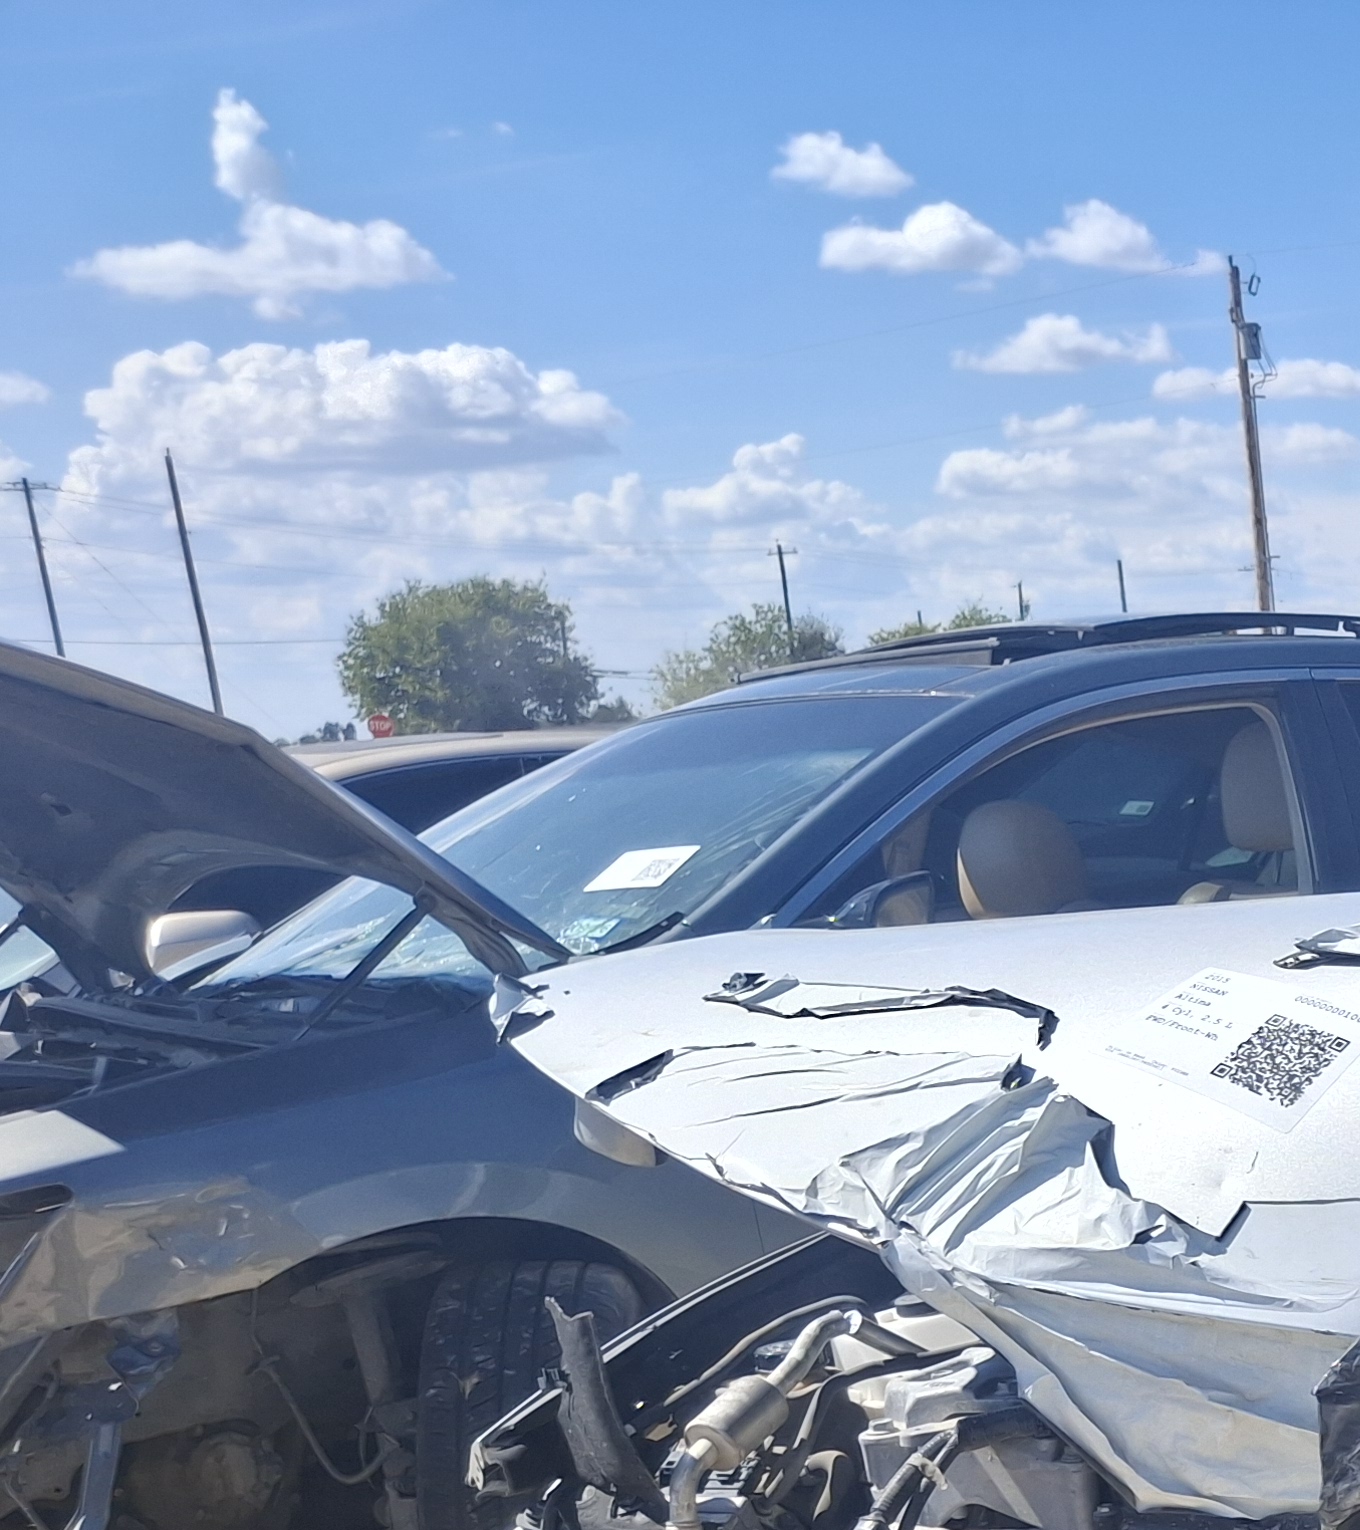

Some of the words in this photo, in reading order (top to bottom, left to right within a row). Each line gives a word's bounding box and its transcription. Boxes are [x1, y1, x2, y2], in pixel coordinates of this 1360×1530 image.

[370, 719, 392, 732] STOP
[1189, 983, 1229, 997] NISSAN
[1174, 993, 1212, 1007] Altima
